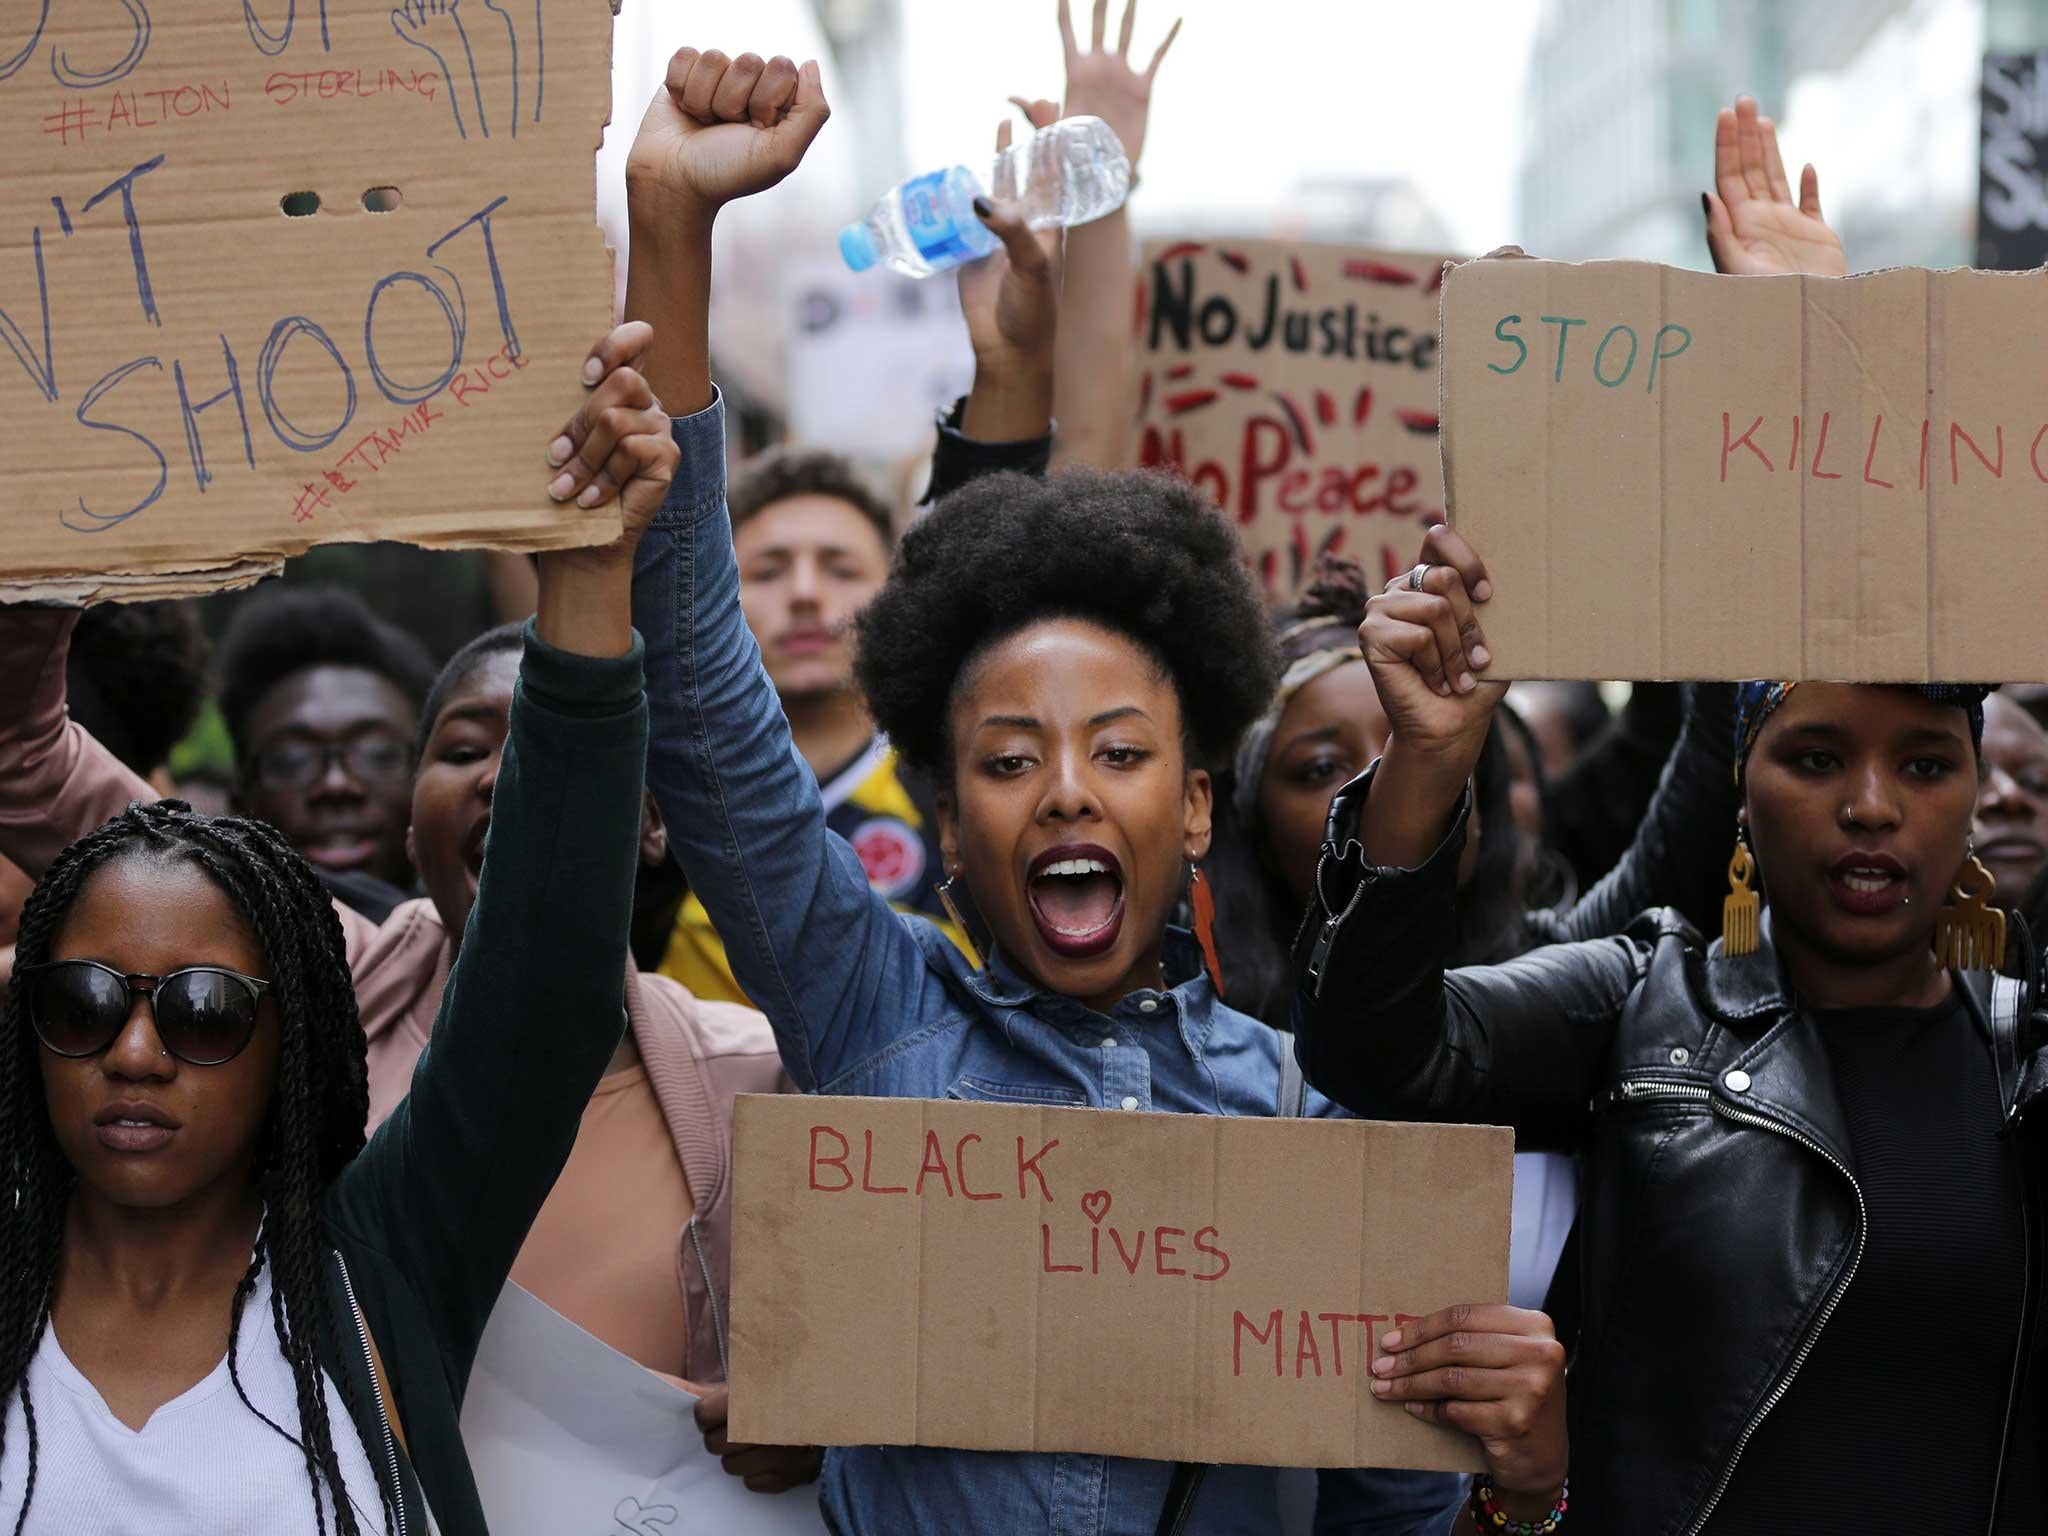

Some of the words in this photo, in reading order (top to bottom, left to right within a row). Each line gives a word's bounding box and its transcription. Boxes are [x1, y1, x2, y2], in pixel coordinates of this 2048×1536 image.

[43, 80, 231, 146] #ALTON
[265, 69, 439, 105] STERLING
[1150, 258, 1237, 352] No
[1249, 272, 1440, 370] Justice
[59, 195, 520, 533] SHOOT
[449, 343, 530, 407] RICE
[1487, 314, 1692, 394] STOP
[1239, 414, 1418, 527] Peace
[808, 1125, 1060, 1203] BLACK
[1041, 1221, 1231, 1281] LIVES
[1232, 1308, 1426, 1379] MATT
